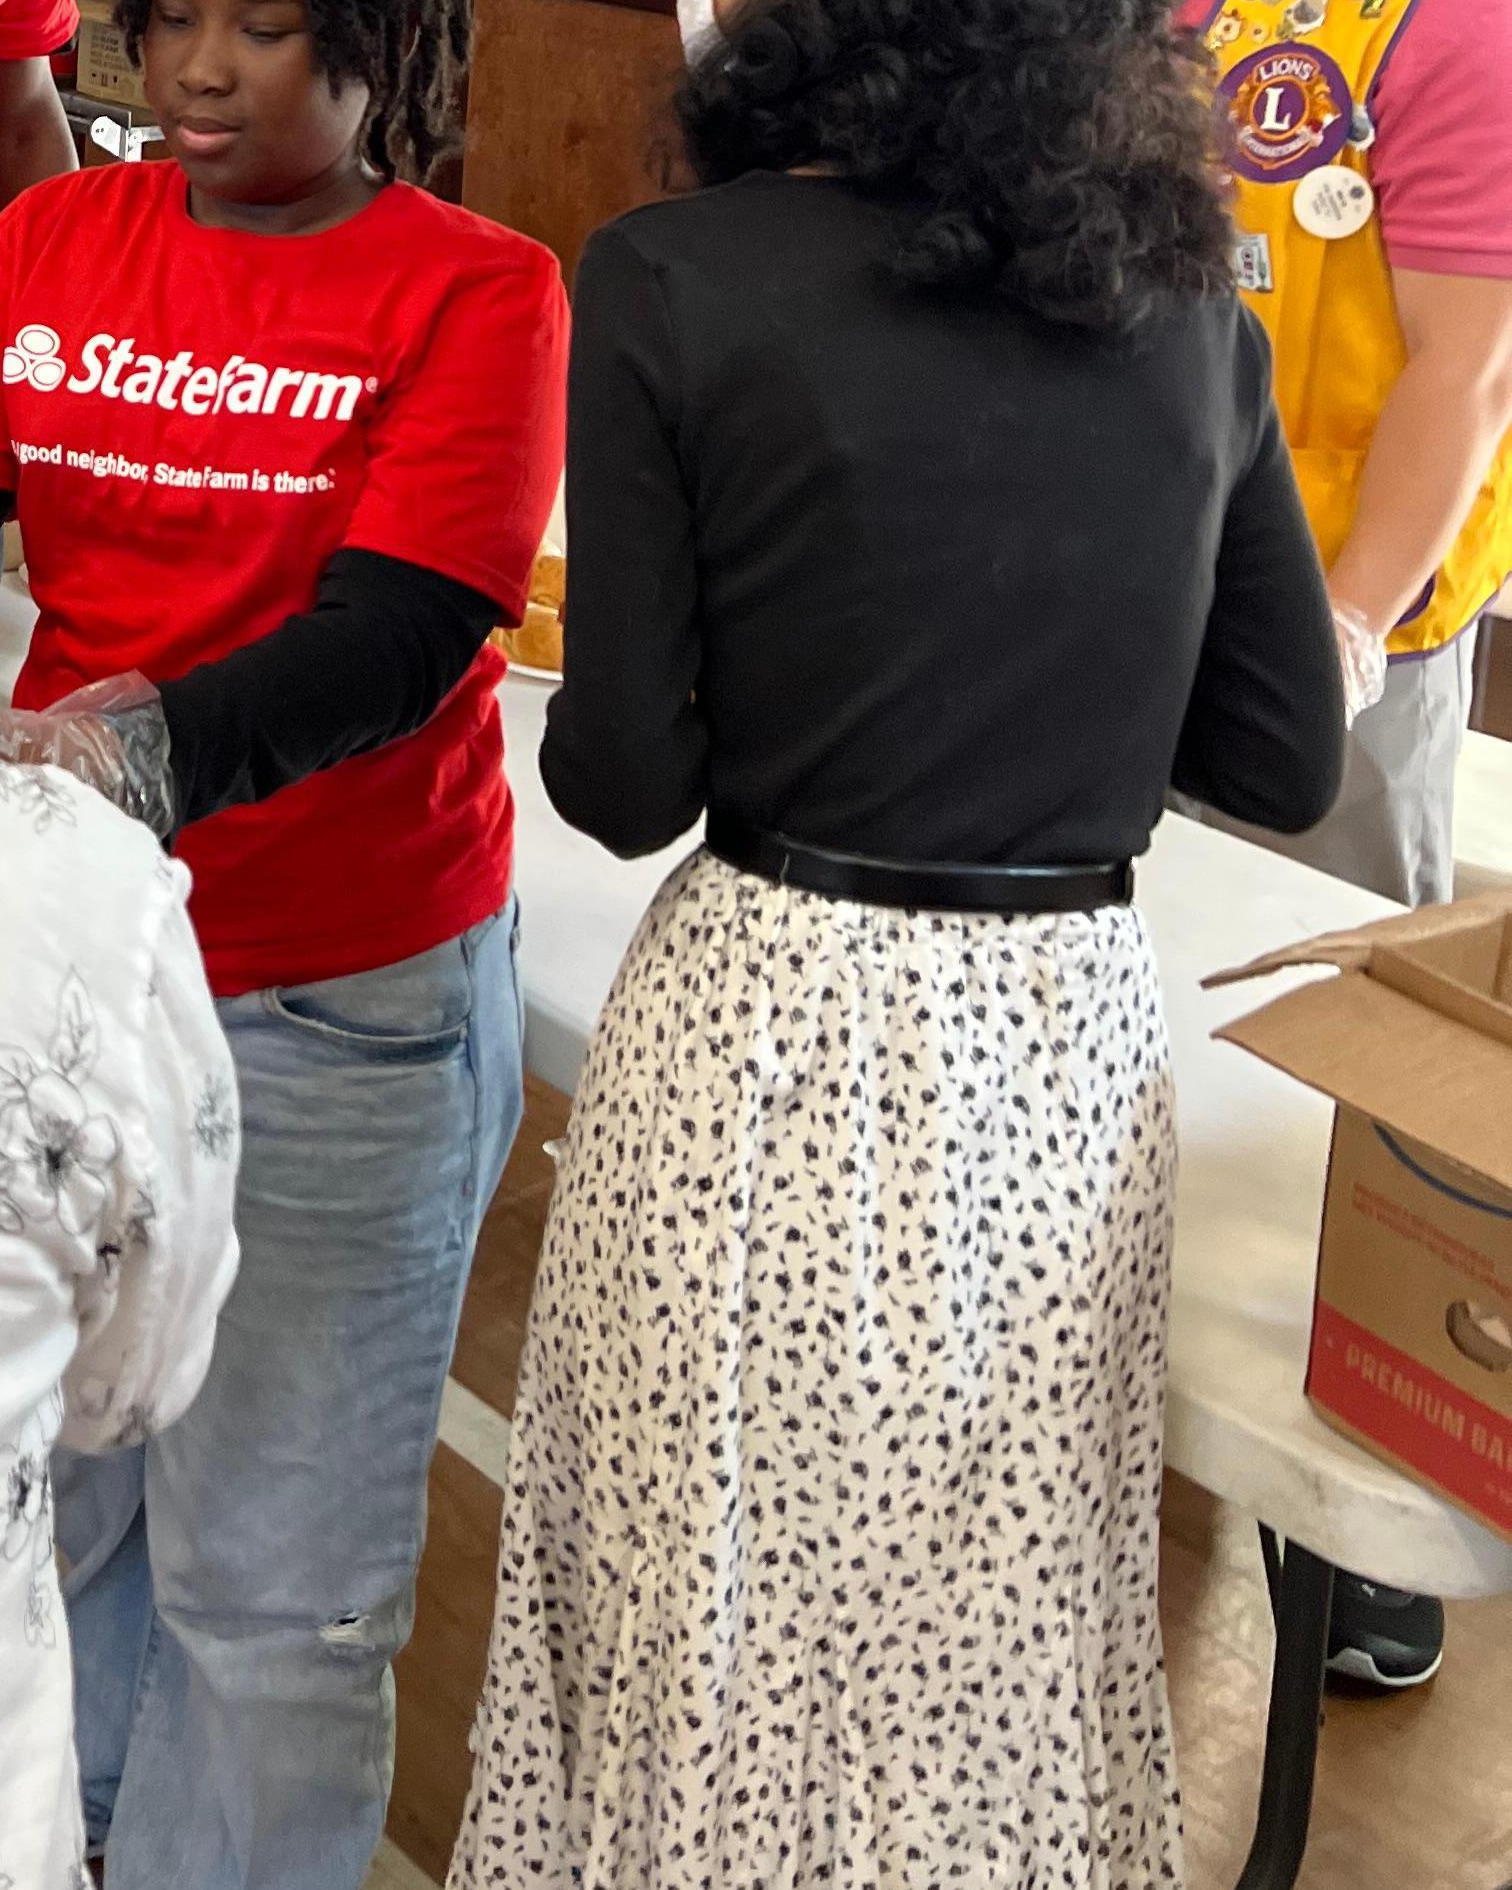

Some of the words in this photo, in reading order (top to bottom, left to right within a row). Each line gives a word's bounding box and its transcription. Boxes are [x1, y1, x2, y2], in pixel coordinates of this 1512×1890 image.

[1259, 59, 1313, 80] LIONS
[1260, 87, 1291, 130] L
[19, 443, 62, 464] good
[67, 449, 149, 484] neighbor,
[251, 469, 269, 491] is
[1345, 1341, 1466, 1442] PREMIUM
